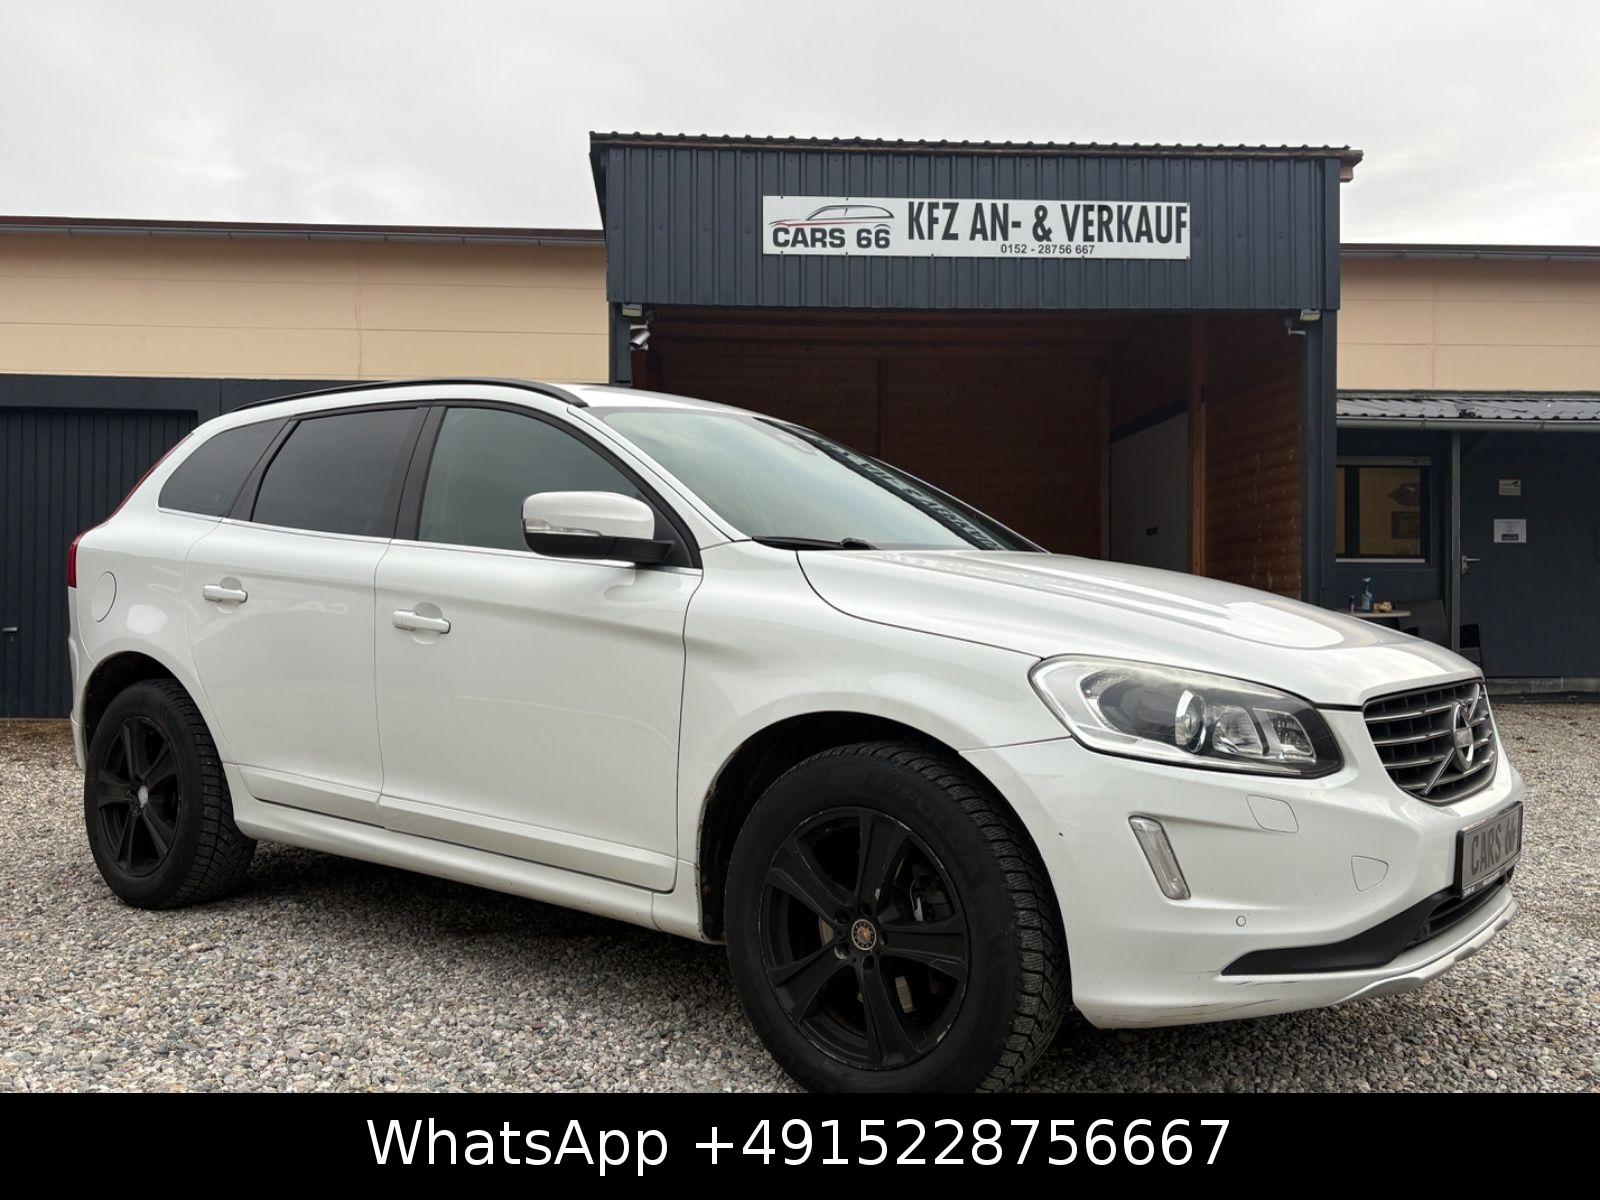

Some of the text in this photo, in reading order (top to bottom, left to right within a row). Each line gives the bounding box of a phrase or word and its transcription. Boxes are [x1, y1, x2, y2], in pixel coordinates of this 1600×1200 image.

[772, 227, 891, 249] CARS 66
[908, 201, 1188, 244] KFZ AN- & VERKAUF
[1000, 243, 1028, 254] 0152
[1038, 244, 1072, 255] 28756
[1075, 245, 1096, 255] 667
[1472, 823, 1502, 876] CARS
